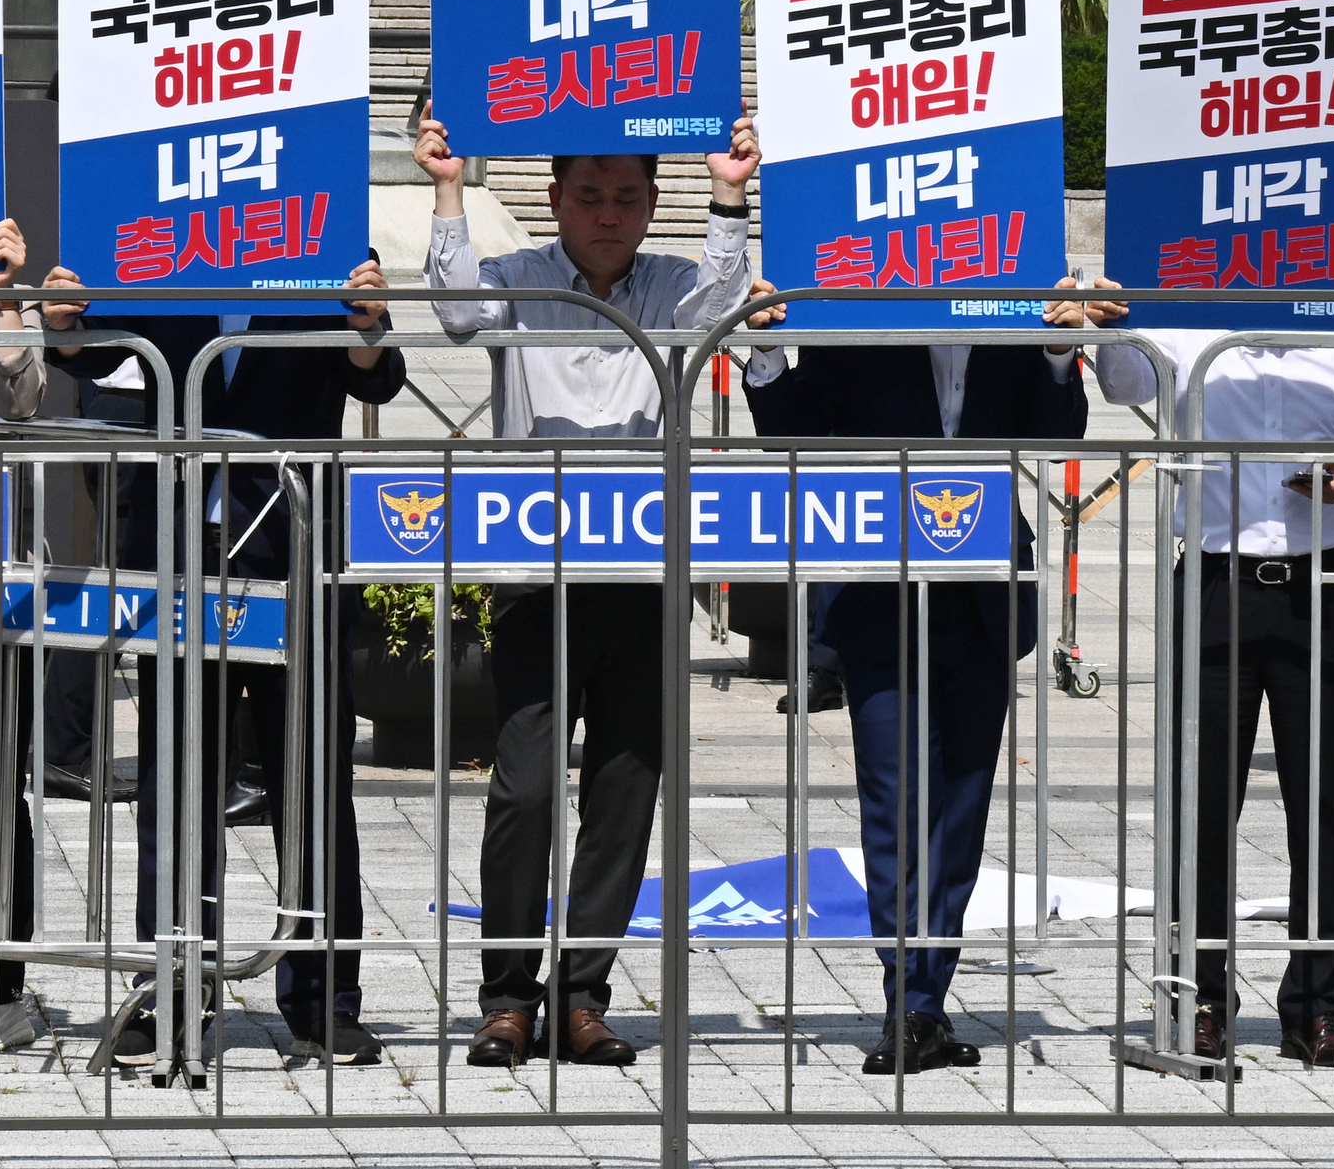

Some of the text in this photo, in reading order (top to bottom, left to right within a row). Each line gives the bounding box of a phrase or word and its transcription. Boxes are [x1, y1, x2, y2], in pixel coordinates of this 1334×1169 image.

[155, 31, 301, 107] 해임!
[487, 31, 700, 123] 총사퇴!
[852, 52, 994, 128] 해임!
[625, 117, 723, 136] 더불어민주당
[158, 127, 283, 202] 내각
[856, 147, 979, 221] 내각
[1202, 158, 1327, 224] 내각
[115, 193, 329, 283] 총사퇴!
[815, 211, 1025, 288] 총사퇴!
[399, 531, 430, 540] POLICE
[478, 490, 719, 545] POLICE
[931, 529, 962, 538] POLICE
